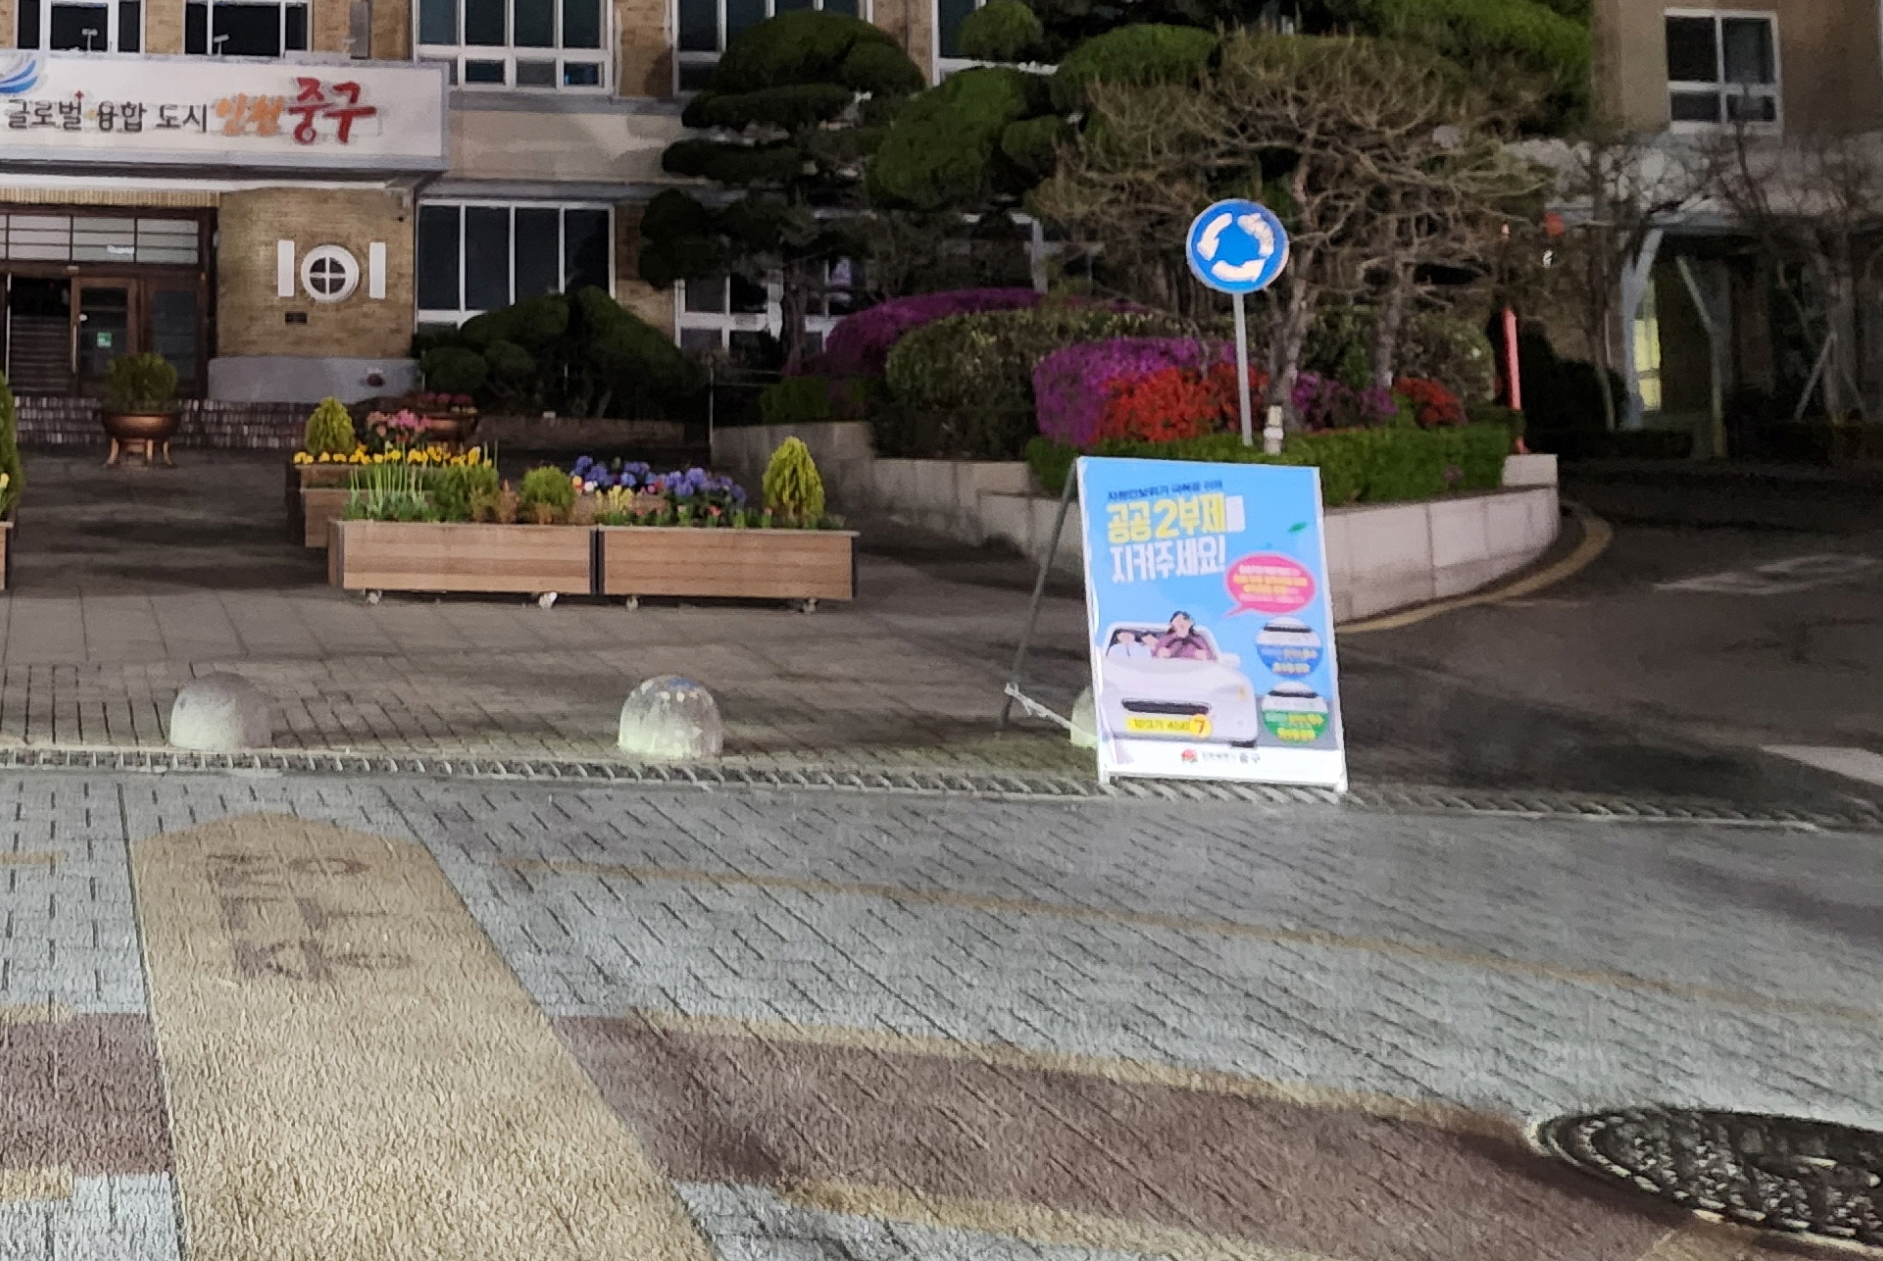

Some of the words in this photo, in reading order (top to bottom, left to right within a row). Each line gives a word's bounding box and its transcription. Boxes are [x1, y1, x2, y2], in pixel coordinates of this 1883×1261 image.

[7, 98, 82, 131] 글로벌
[97, 101, 148, 133] 융합
[155, 103, 208, 133] 도시
[288, 77, 377, 145] 중구
[1106, 501, 1152, 544] 공공
[1109, 534, 1225, 585] 지켜주세요!
